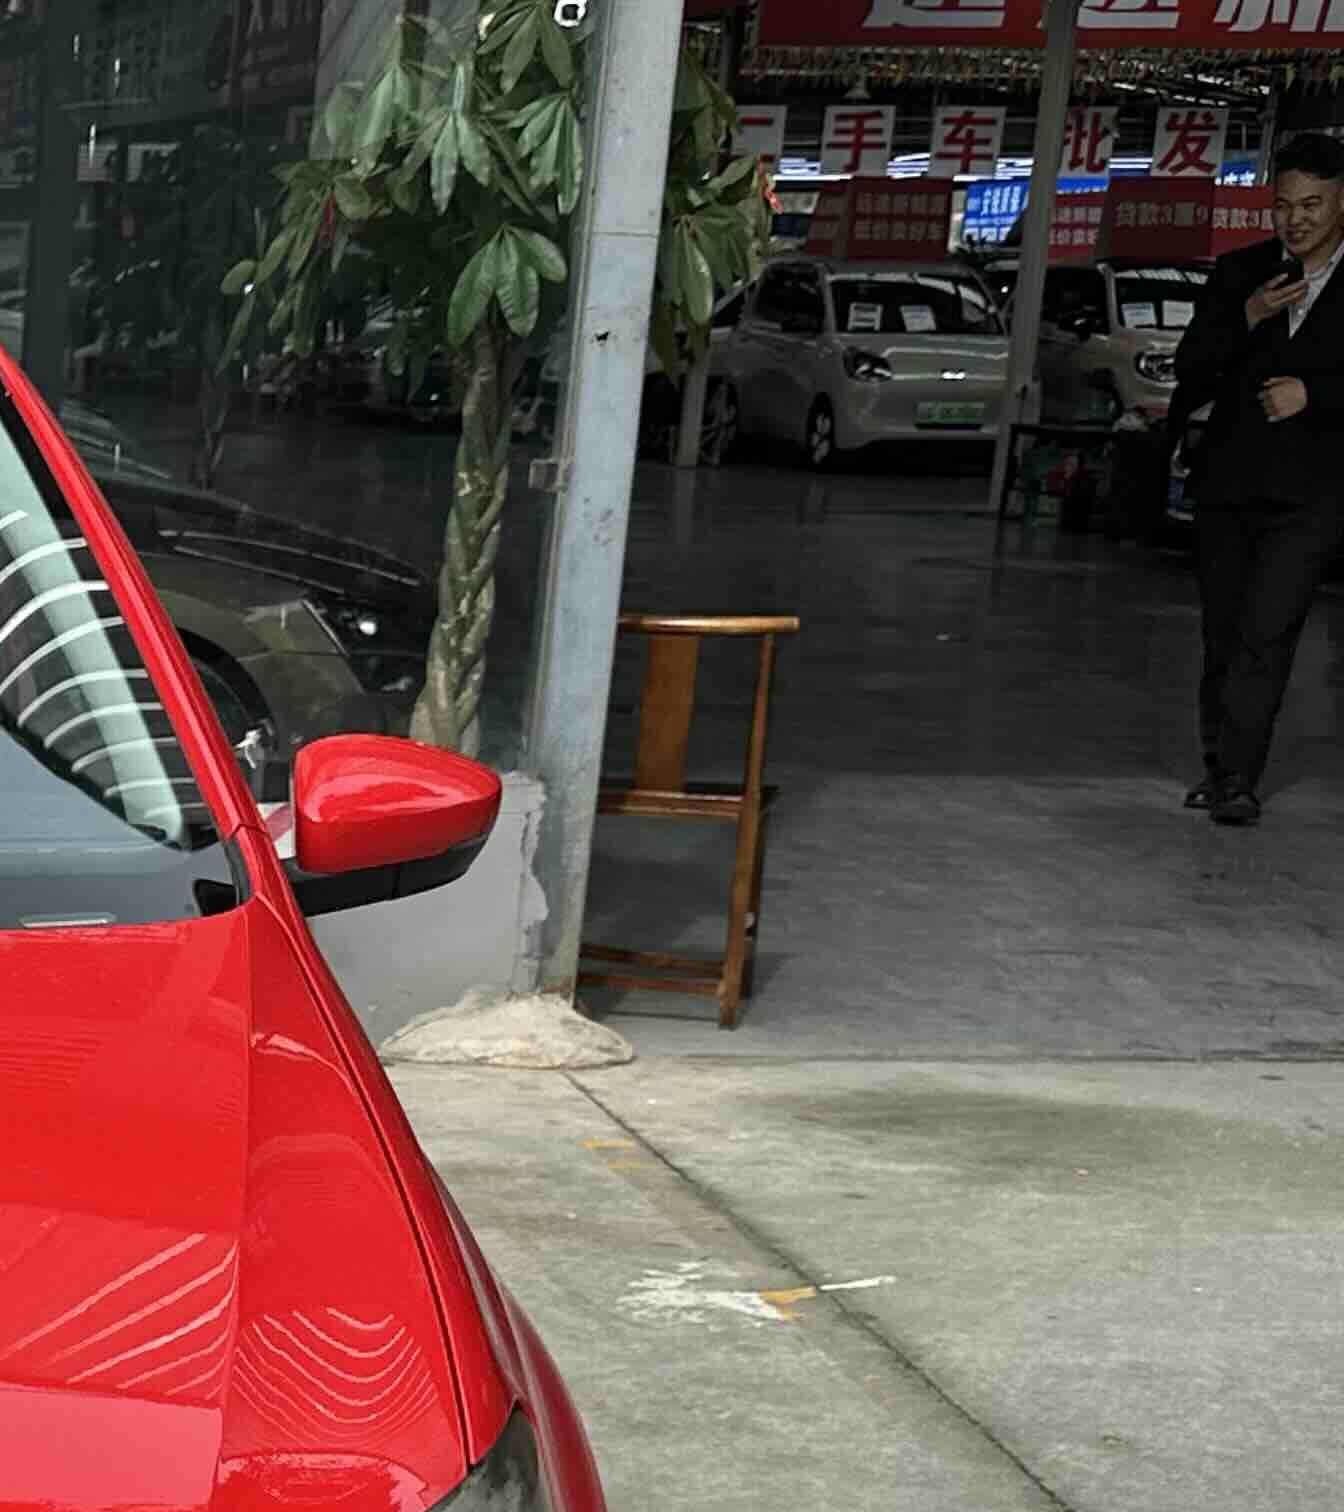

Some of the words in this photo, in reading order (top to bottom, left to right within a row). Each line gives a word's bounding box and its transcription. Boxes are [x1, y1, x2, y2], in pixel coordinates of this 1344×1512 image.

[722, 112, 1222, 176] 二手车批发
